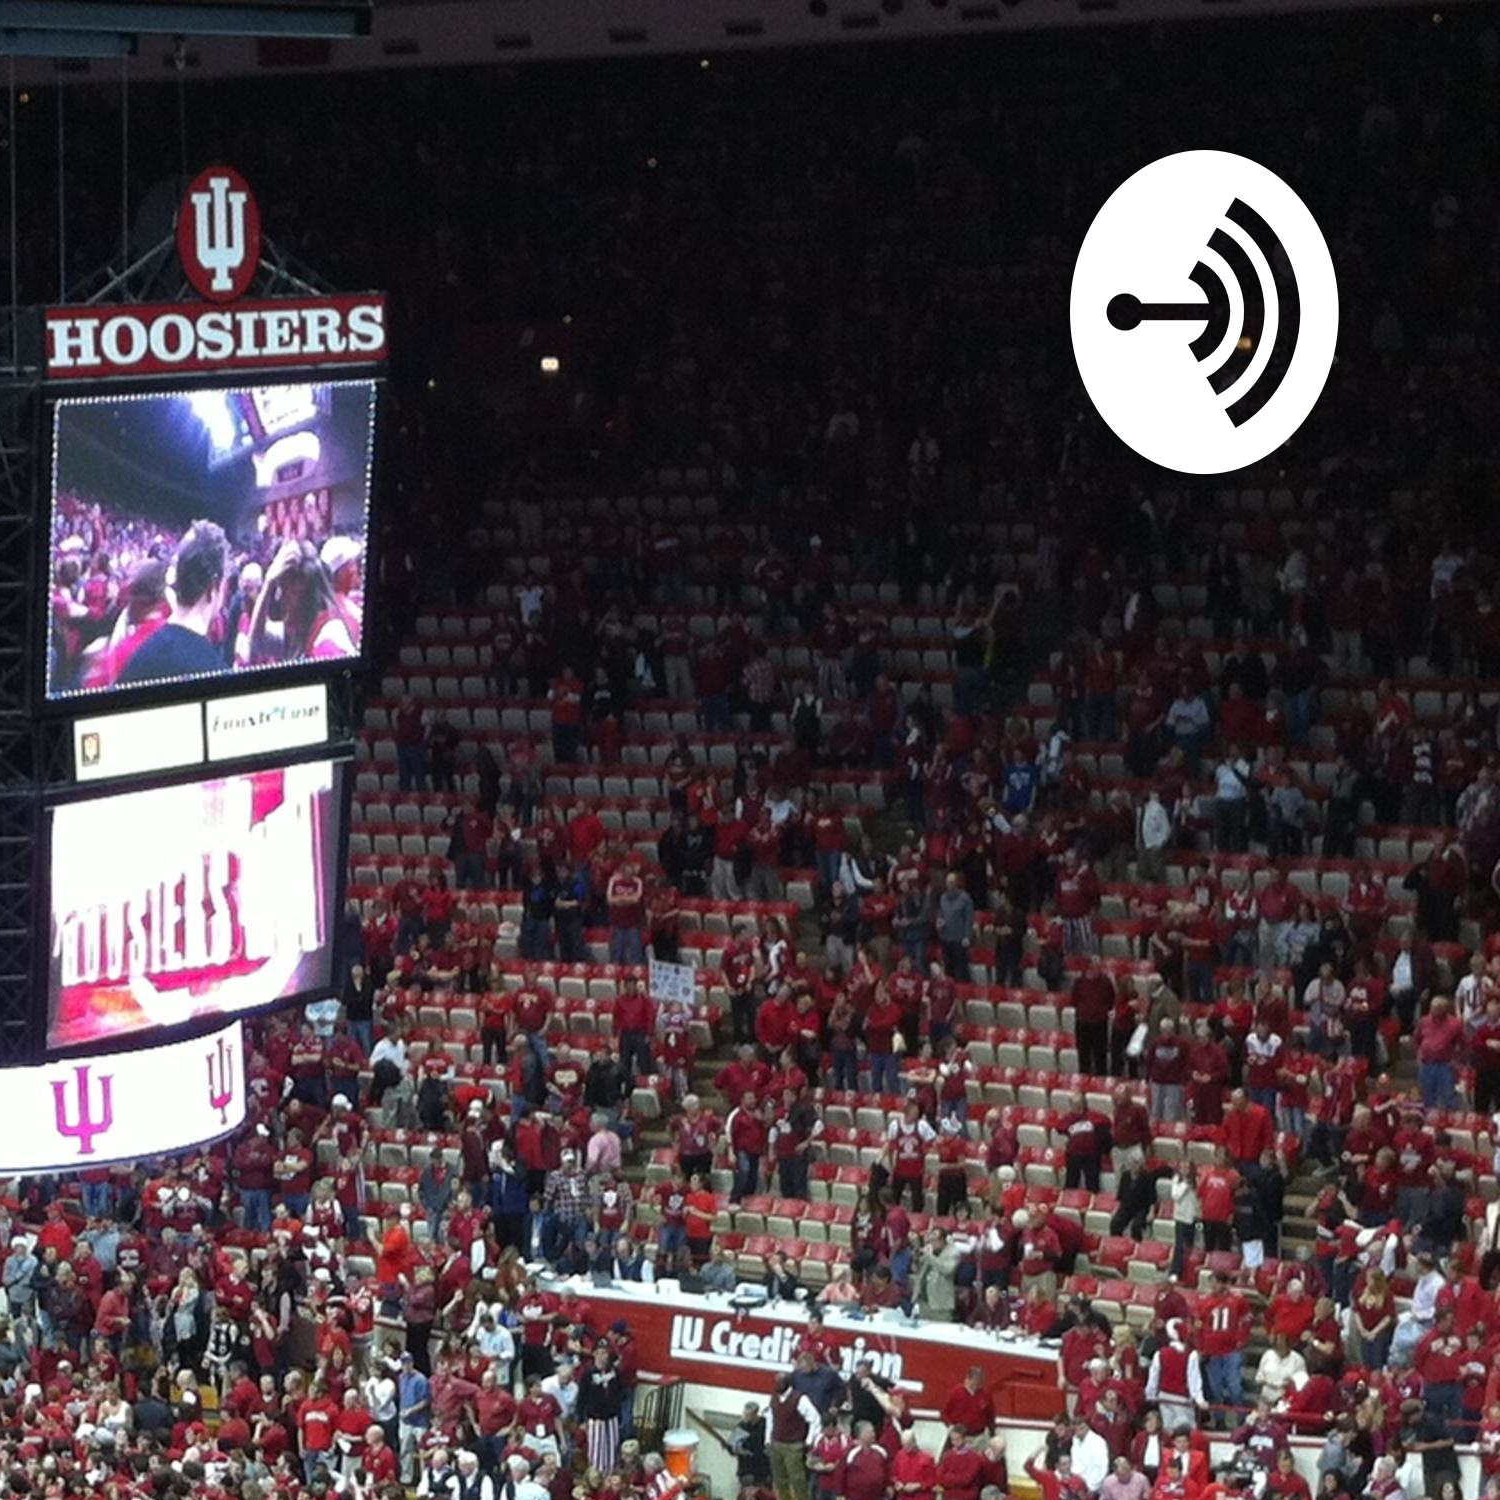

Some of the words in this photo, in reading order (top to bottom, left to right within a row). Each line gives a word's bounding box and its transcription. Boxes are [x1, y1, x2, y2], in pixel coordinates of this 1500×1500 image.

[46, 305, 385, 368] HOOSIERS
[670, 1314, 705, 1352] IU
[839, 1336, 903, 1383] ion
[1211, 1306, 1229, 1332] 11
